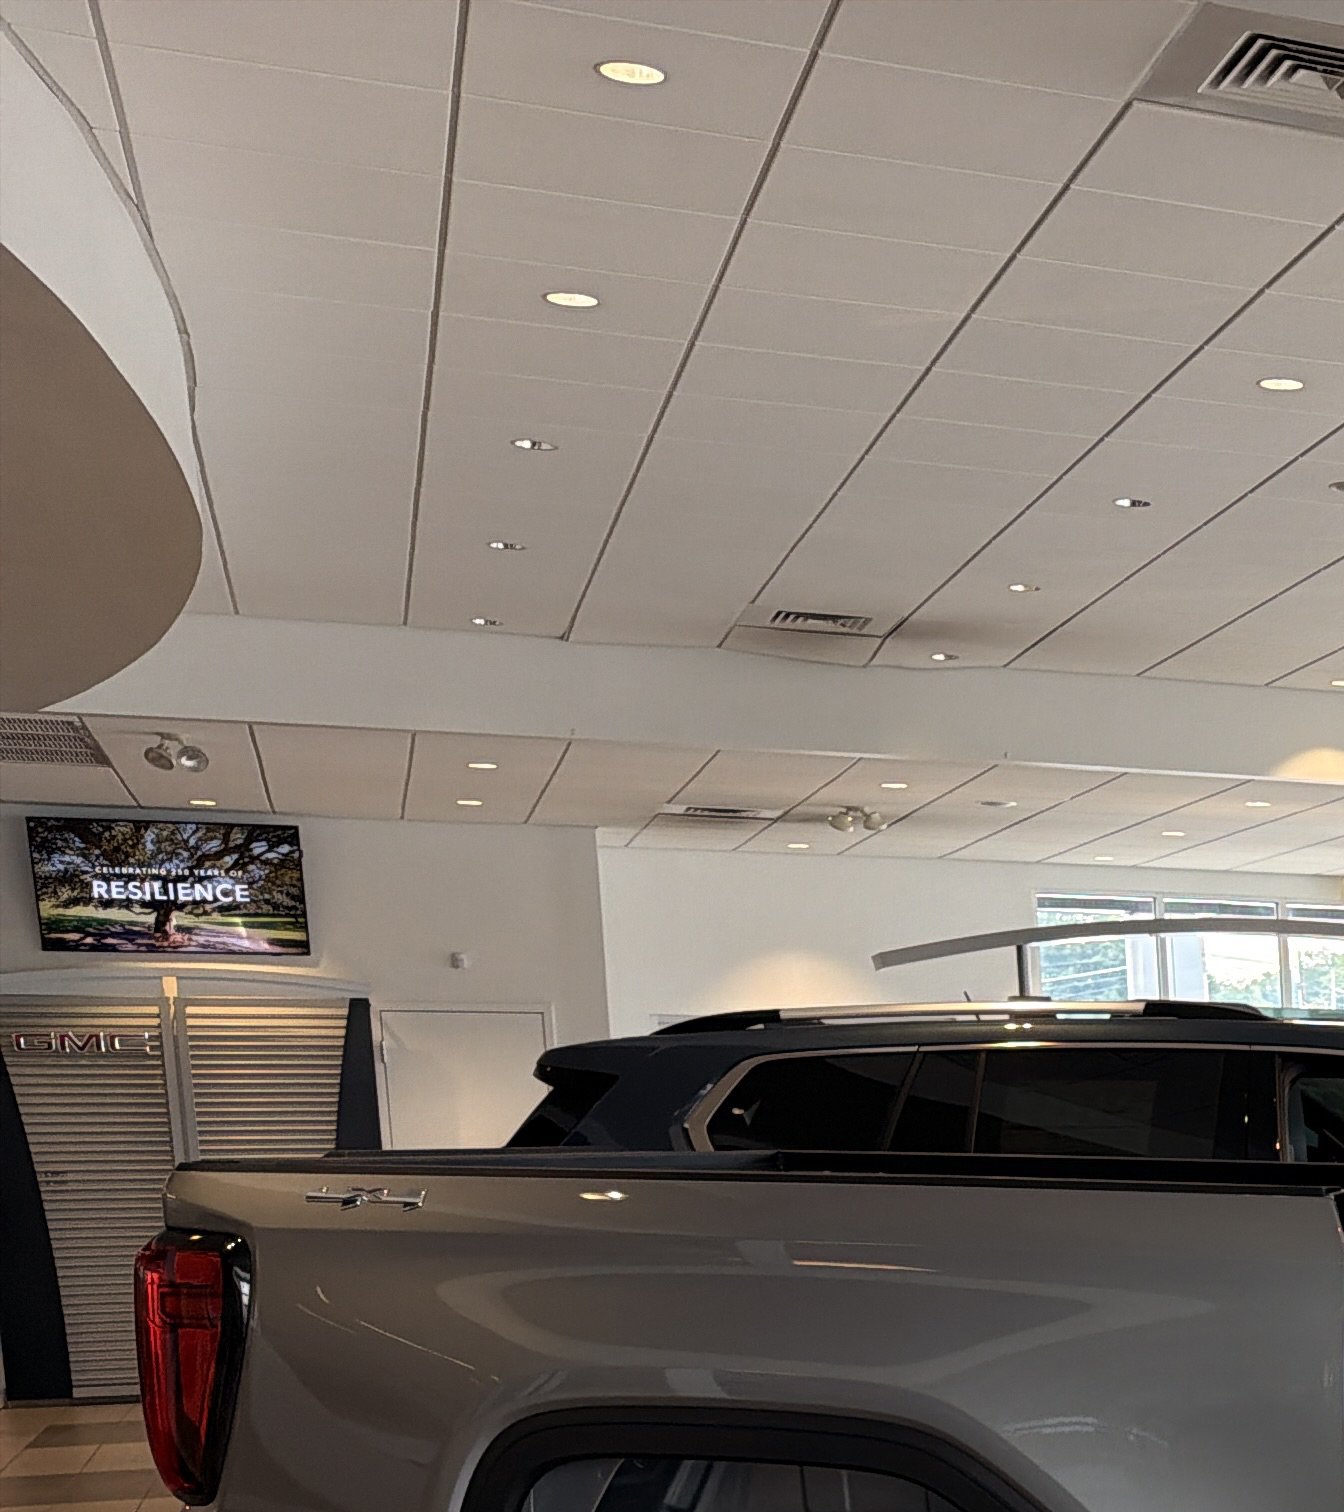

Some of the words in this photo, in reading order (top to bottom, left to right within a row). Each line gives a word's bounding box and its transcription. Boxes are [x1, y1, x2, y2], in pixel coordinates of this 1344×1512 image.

[94, 866, 167, 876] CELEBRATING
[193, 869, 226, 877] YEARS
[92, 880, 250, 902] RESILIENCE
[12, 1031, 149, 1053] GMC
